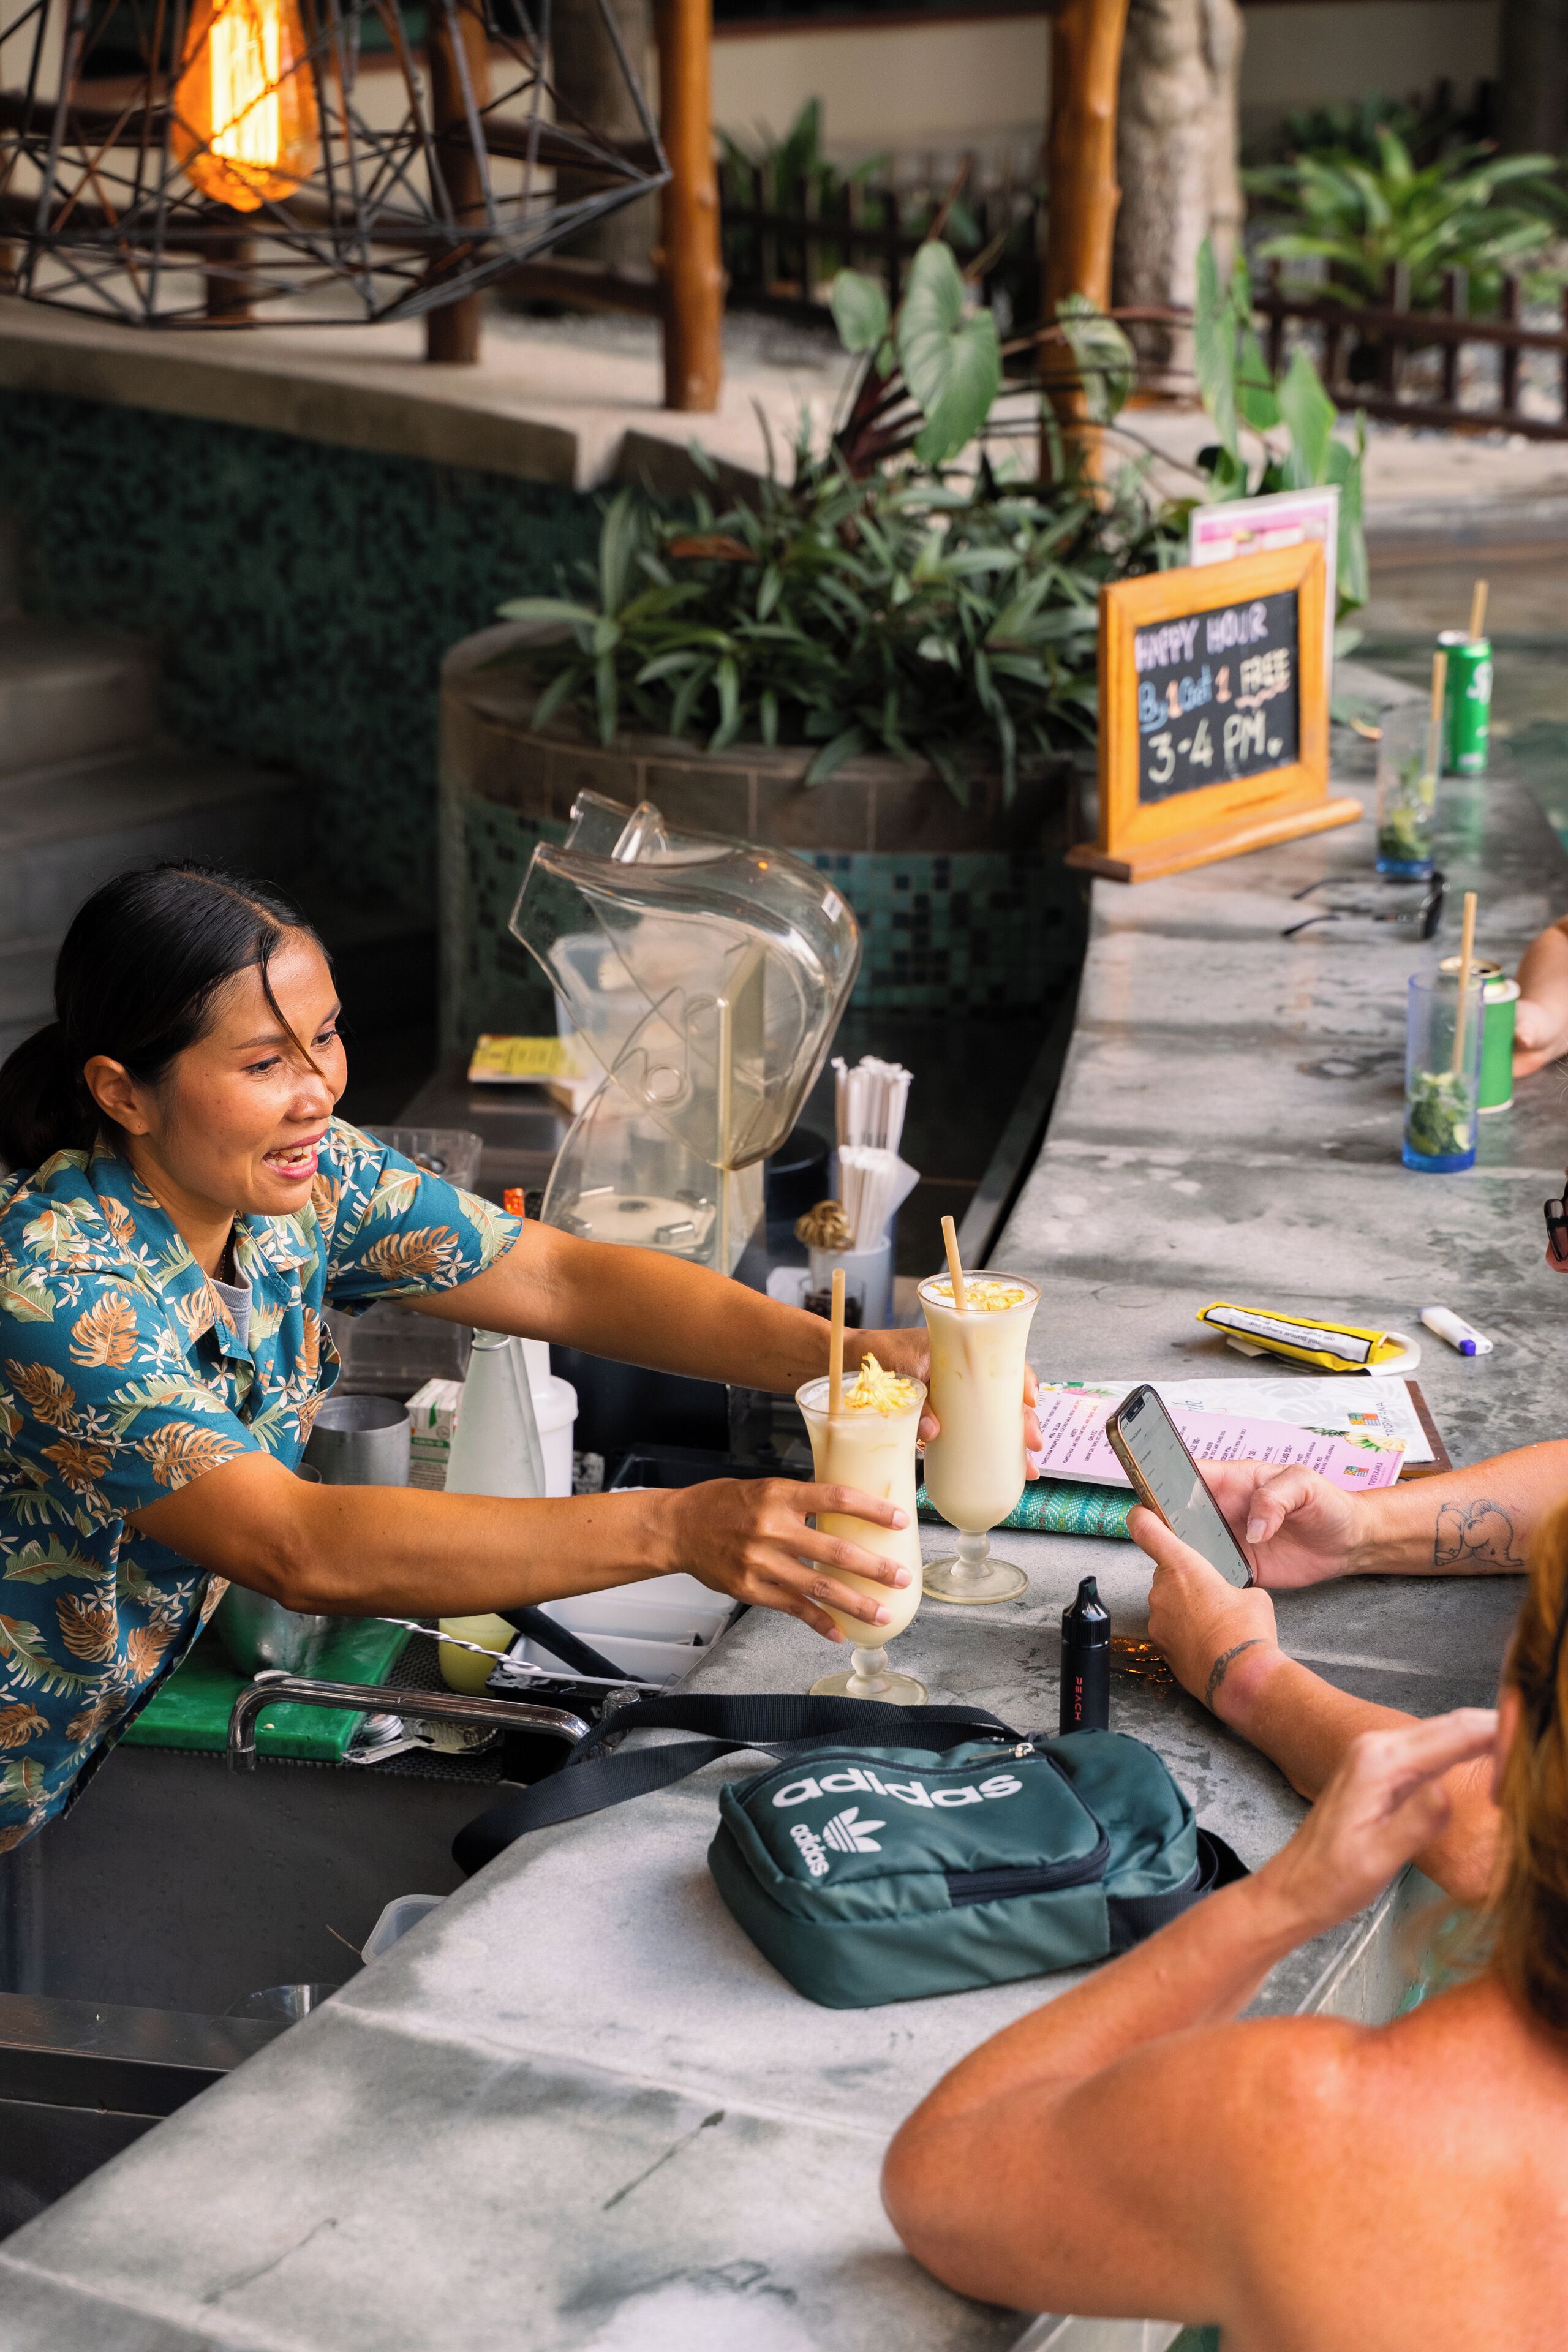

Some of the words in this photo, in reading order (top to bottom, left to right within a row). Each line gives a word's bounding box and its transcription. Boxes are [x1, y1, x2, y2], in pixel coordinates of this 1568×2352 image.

[1135, 617, 1199, 672] HAPPY
[1207, 601, 1268, 655] HOUR
[1215, 665, 1232, 703] 1
[1240, 647, 1291, 696] FREE
[1376, 1401, 1396, 1436] TROPIKANA
[1368, 1462, 1384, 1486] TROPIKANA
[1074, 1676, 1083, 1721] PEACH
[772, 1768, 1023, 1809] adidas
[790, 1823, 830, 1877] adidas
